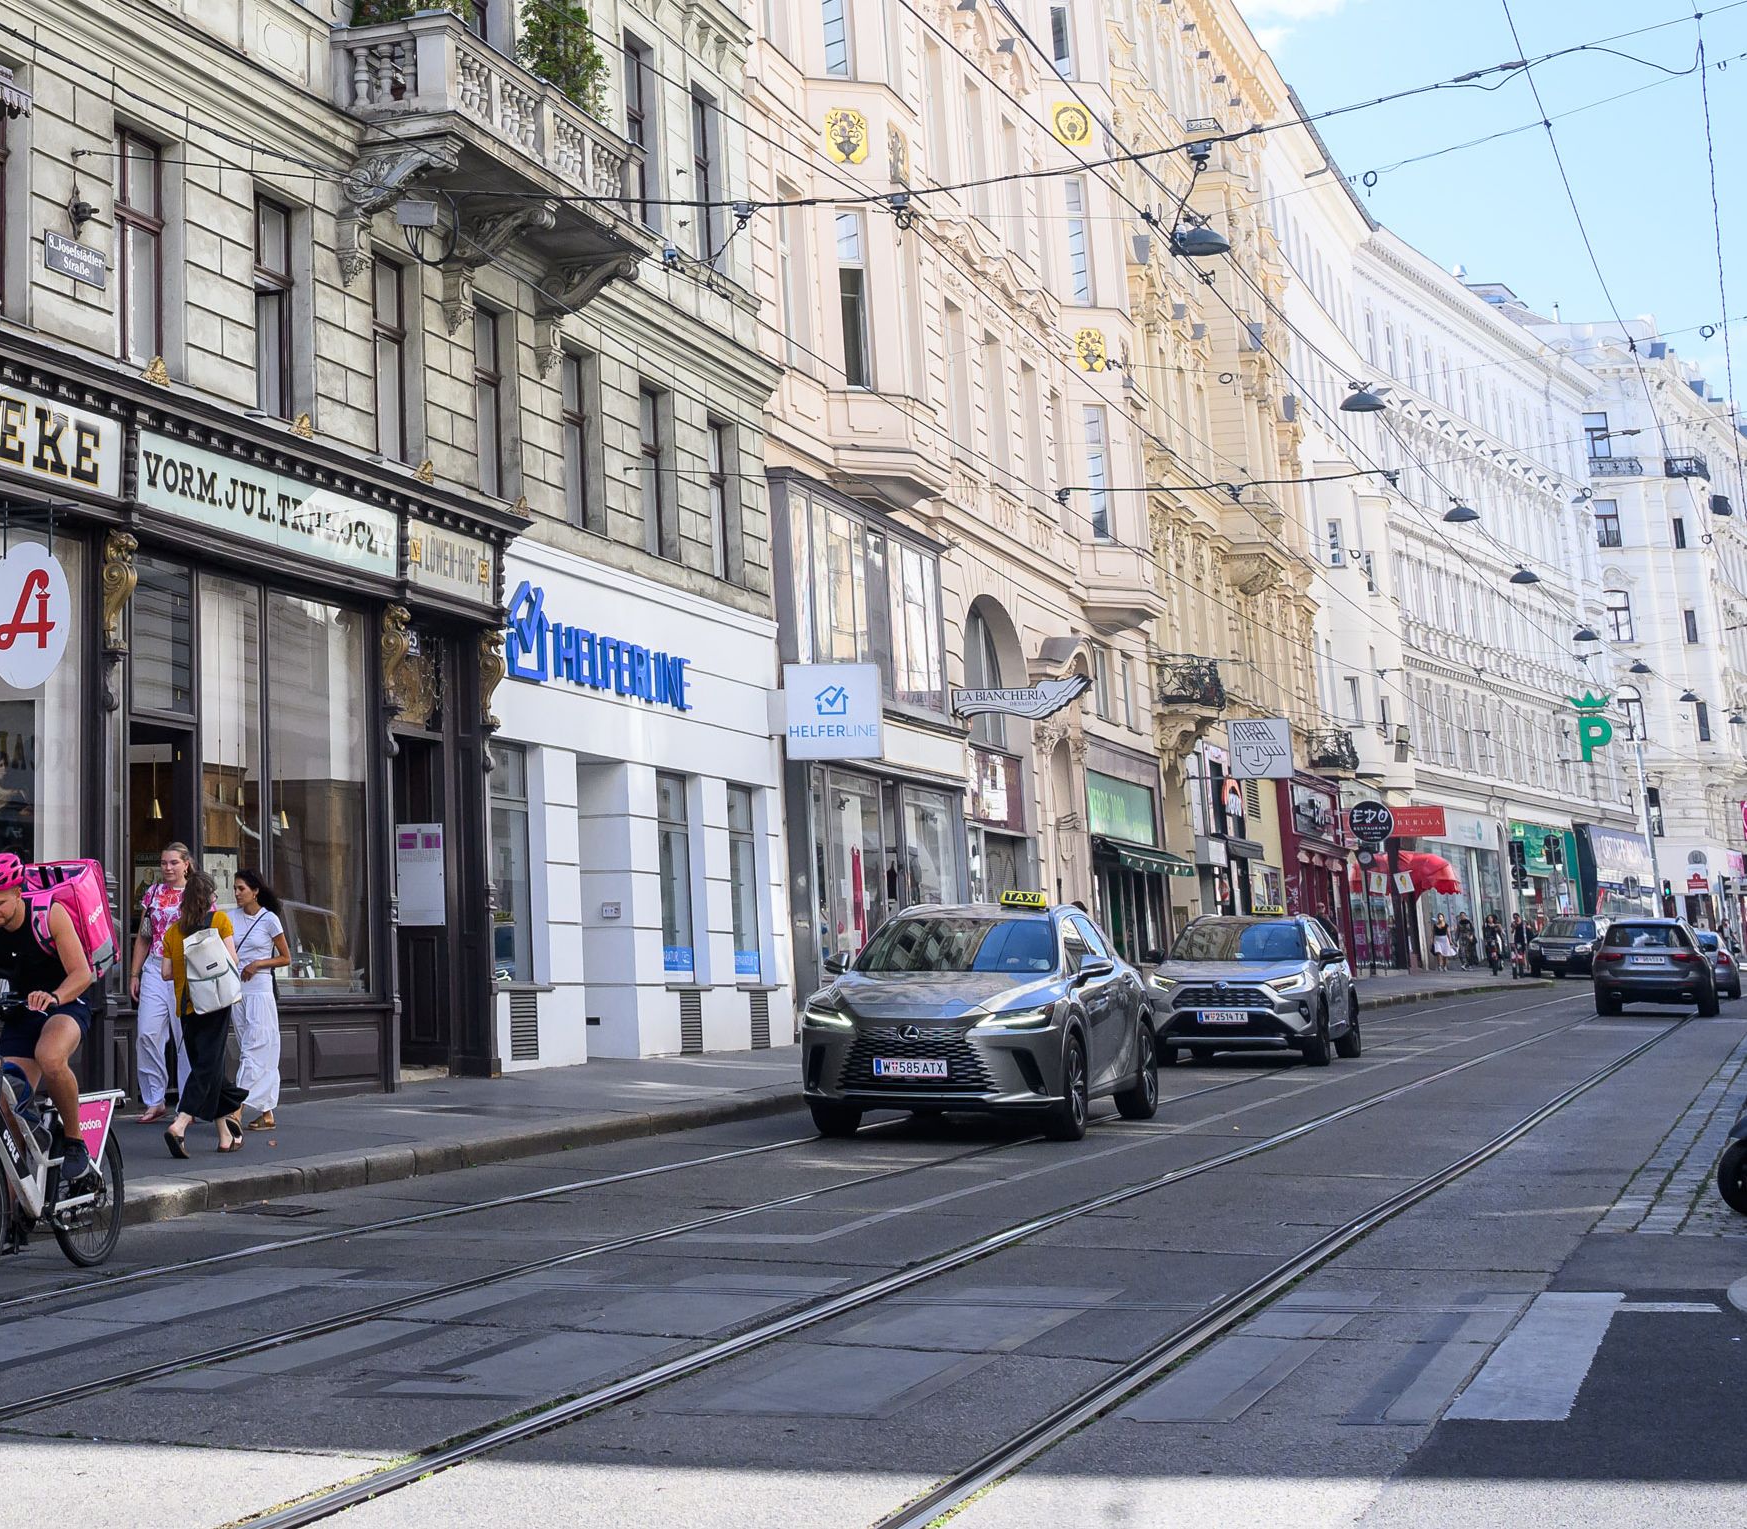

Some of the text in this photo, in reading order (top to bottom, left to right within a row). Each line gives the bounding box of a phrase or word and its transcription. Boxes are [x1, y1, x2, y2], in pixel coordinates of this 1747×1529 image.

[63, 256, 90, 277] Straße
[480, 563, 488, 579] 25
[553, 622, 693, 711] HELFERLINE
[956, 689, 1048, 702] LA BIANCHERIA
[789, 724, 877, 738] HELFERLINE
[1353, 809, 1388, 823] EDO
[1005, 892, 1040, 903] TAXI
